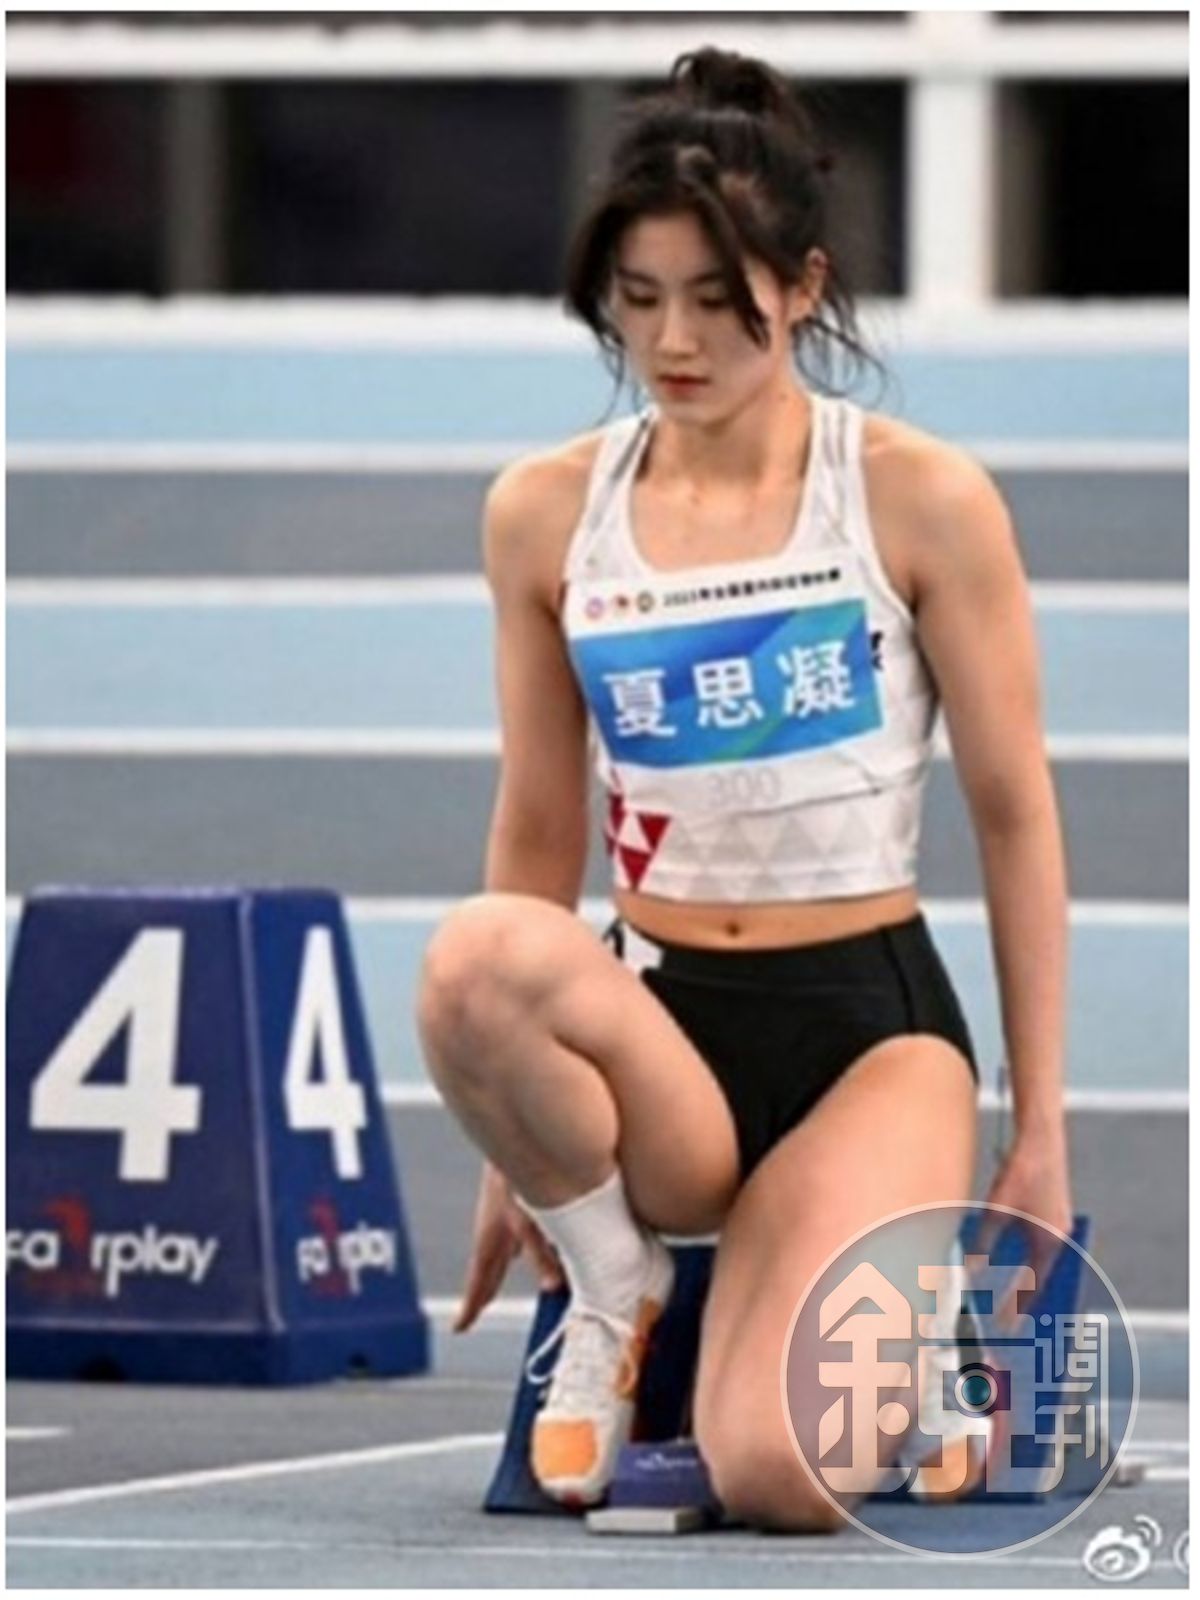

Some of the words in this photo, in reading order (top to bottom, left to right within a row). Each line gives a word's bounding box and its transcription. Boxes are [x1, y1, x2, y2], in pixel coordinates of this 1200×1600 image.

[603, 640, 856, 738] 夏思凝
[30, 927, 202, 1182] 4
[283, 927, 367, 1181] 4
